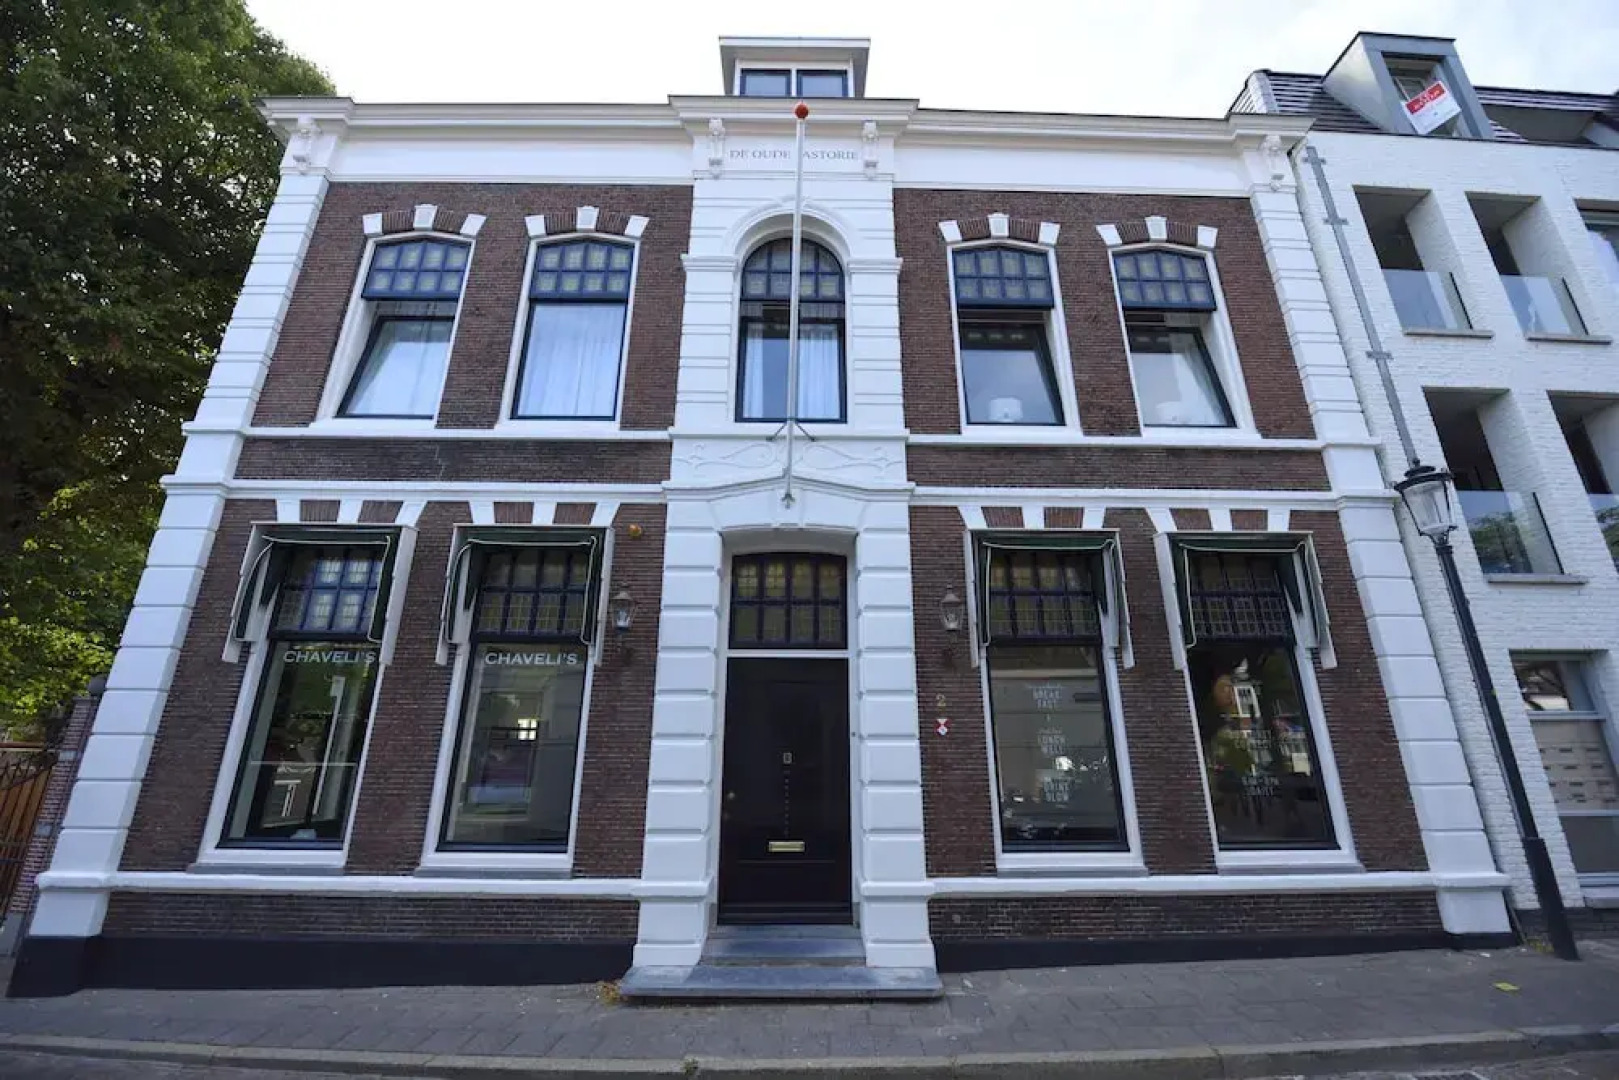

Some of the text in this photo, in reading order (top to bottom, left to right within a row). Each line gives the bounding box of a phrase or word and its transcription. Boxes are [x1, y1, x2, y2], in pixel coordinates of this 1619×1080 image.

[729, 149, 858, 160] DE OUDE ASTORIE
[282, 650, 376, 664] CHAVELI'S
[485, 652, 578, 665] CHAVELI'S
